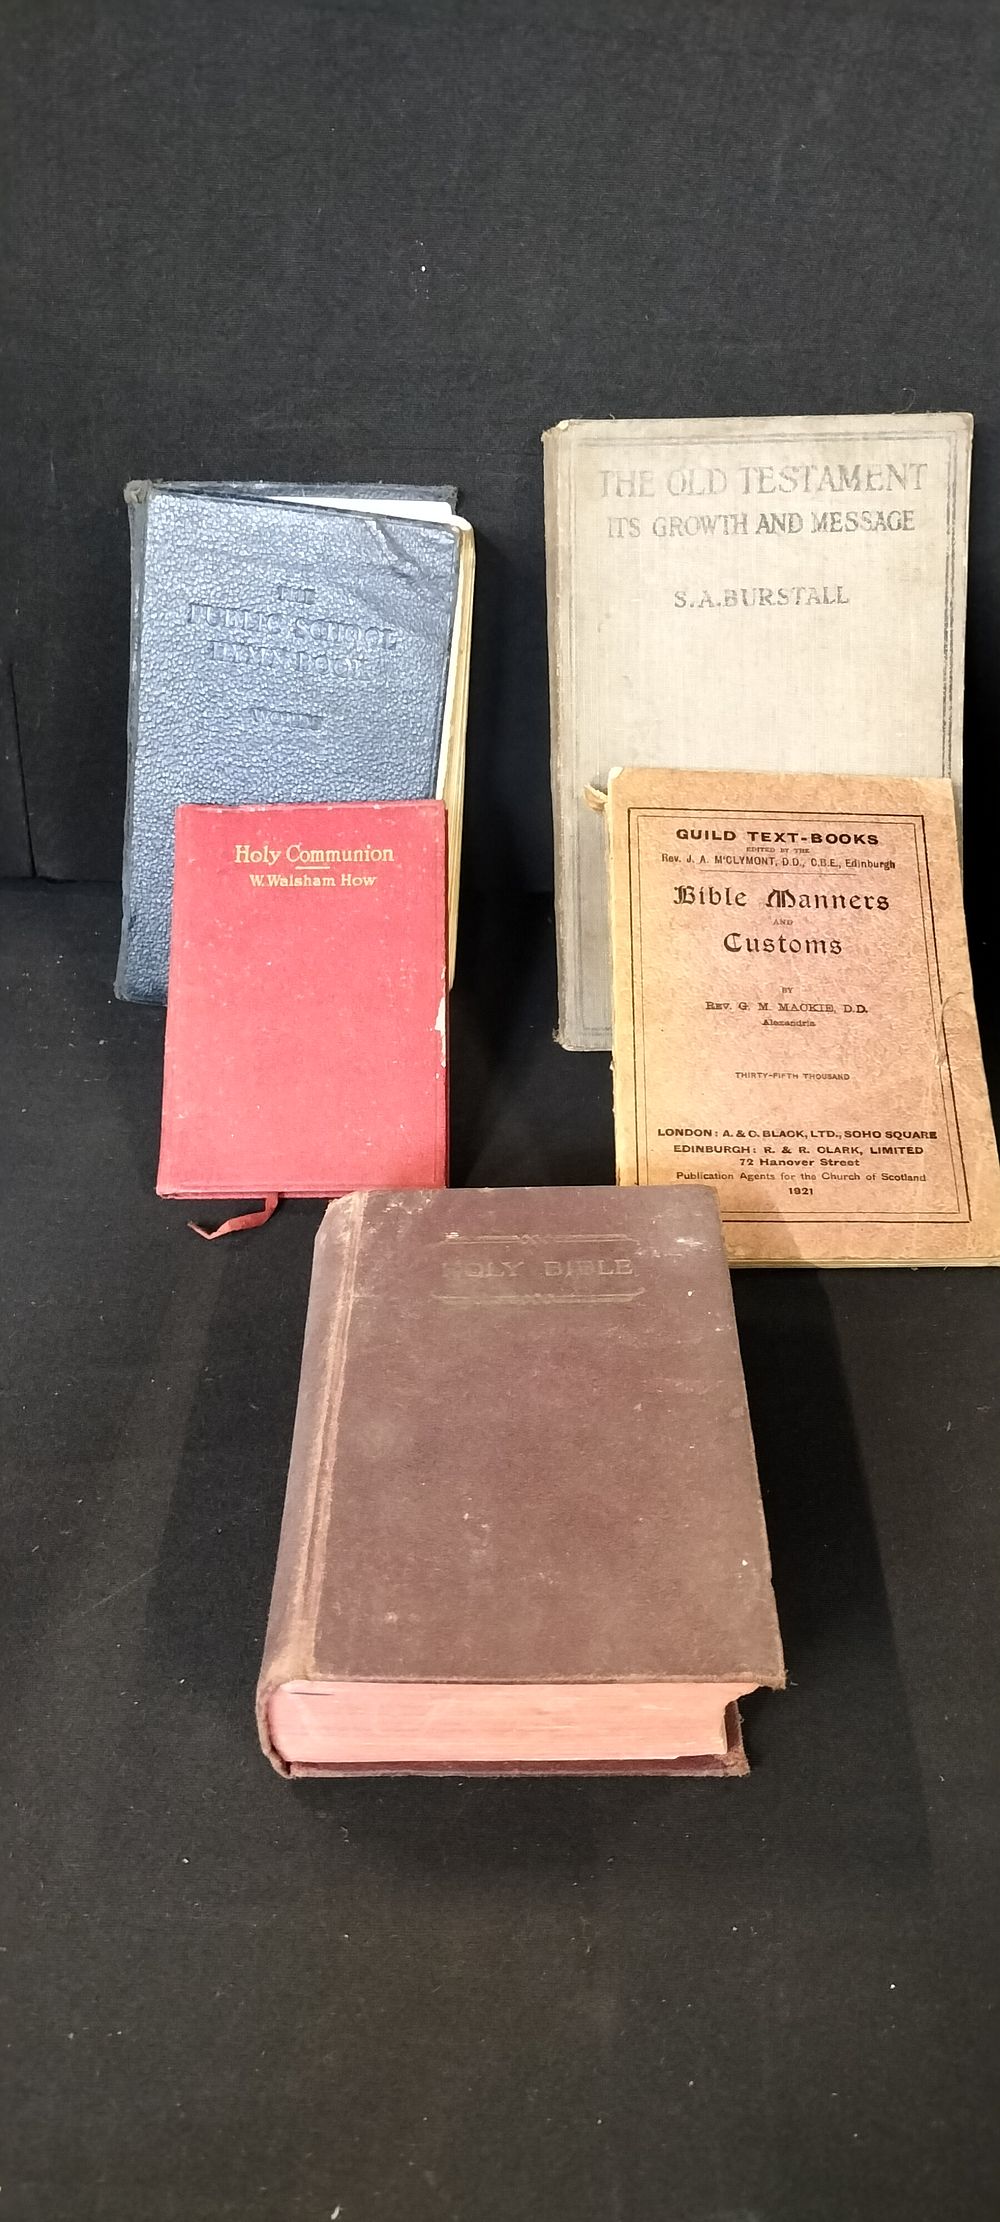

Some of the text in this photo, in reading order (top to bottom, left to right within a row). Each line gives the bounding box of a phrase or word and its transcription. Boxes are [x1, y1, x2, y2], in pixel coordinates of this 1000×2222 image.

[600, 464, 927, 497] THE OLD TESTAMENT
[607, 510, 915, 538] ITS GROWTH AND MESSAGE
[188, 603, 397, 650] PUBLIC SCHOOL
[676, 829, 879, 845] GUILD TEXT-BOOKS
[234, 844, 395, 866] Holy Communion
[661, 853, 682, 863] Rev.
[686, 855, 695, 863] J.
[700, 855, 710, 864] A.
[782, 857, 805, 867] D.D.,
[845, 858, 896, 870] Edinburgh
[341, 873, 377, 887] How
[673, 885, 890, 910] Bible Manners
[724, 932, 842, 954] Customs
[782, 986, 793, 994] BY
[738, 1002, 750, 1011] G.
[778, 1003, 838, 1014] MACKIE,
[843, 1004, 868, 1013] D.D.
[761, 1018, 816, 1027] Alexandria
[803, 1073, 850, 1081] THOUSAND
[722, 1129, 734, 1138] A.
[736, 1129, 746, 1138] &
[748, 1130, 760, 1138] C.
[762, 1130, 808, 1139] BLACK,
[810, 1130, 842, 1139] LTD.,
[844, 1130, 882, 1139] SOHO
[885, 1130, 937, 1140] SQUARE
[764, 1146, 776, 1154] R.
[781, 1146, 792, 1154] &
[799, 1146, 810, 1154] R.
[817, 1146, 863, 1155] CLARK,
[870, 1146, 924, 1155] LIMITED
[739, 1158, 860, 1166] 72 Hanover Street
[676, 1171, 926, 1182] Publication Agents for the Church of Scotland
[788, 1187, 814, 1195] 1921
[543, 1259, 634, 1277] BIBLE
